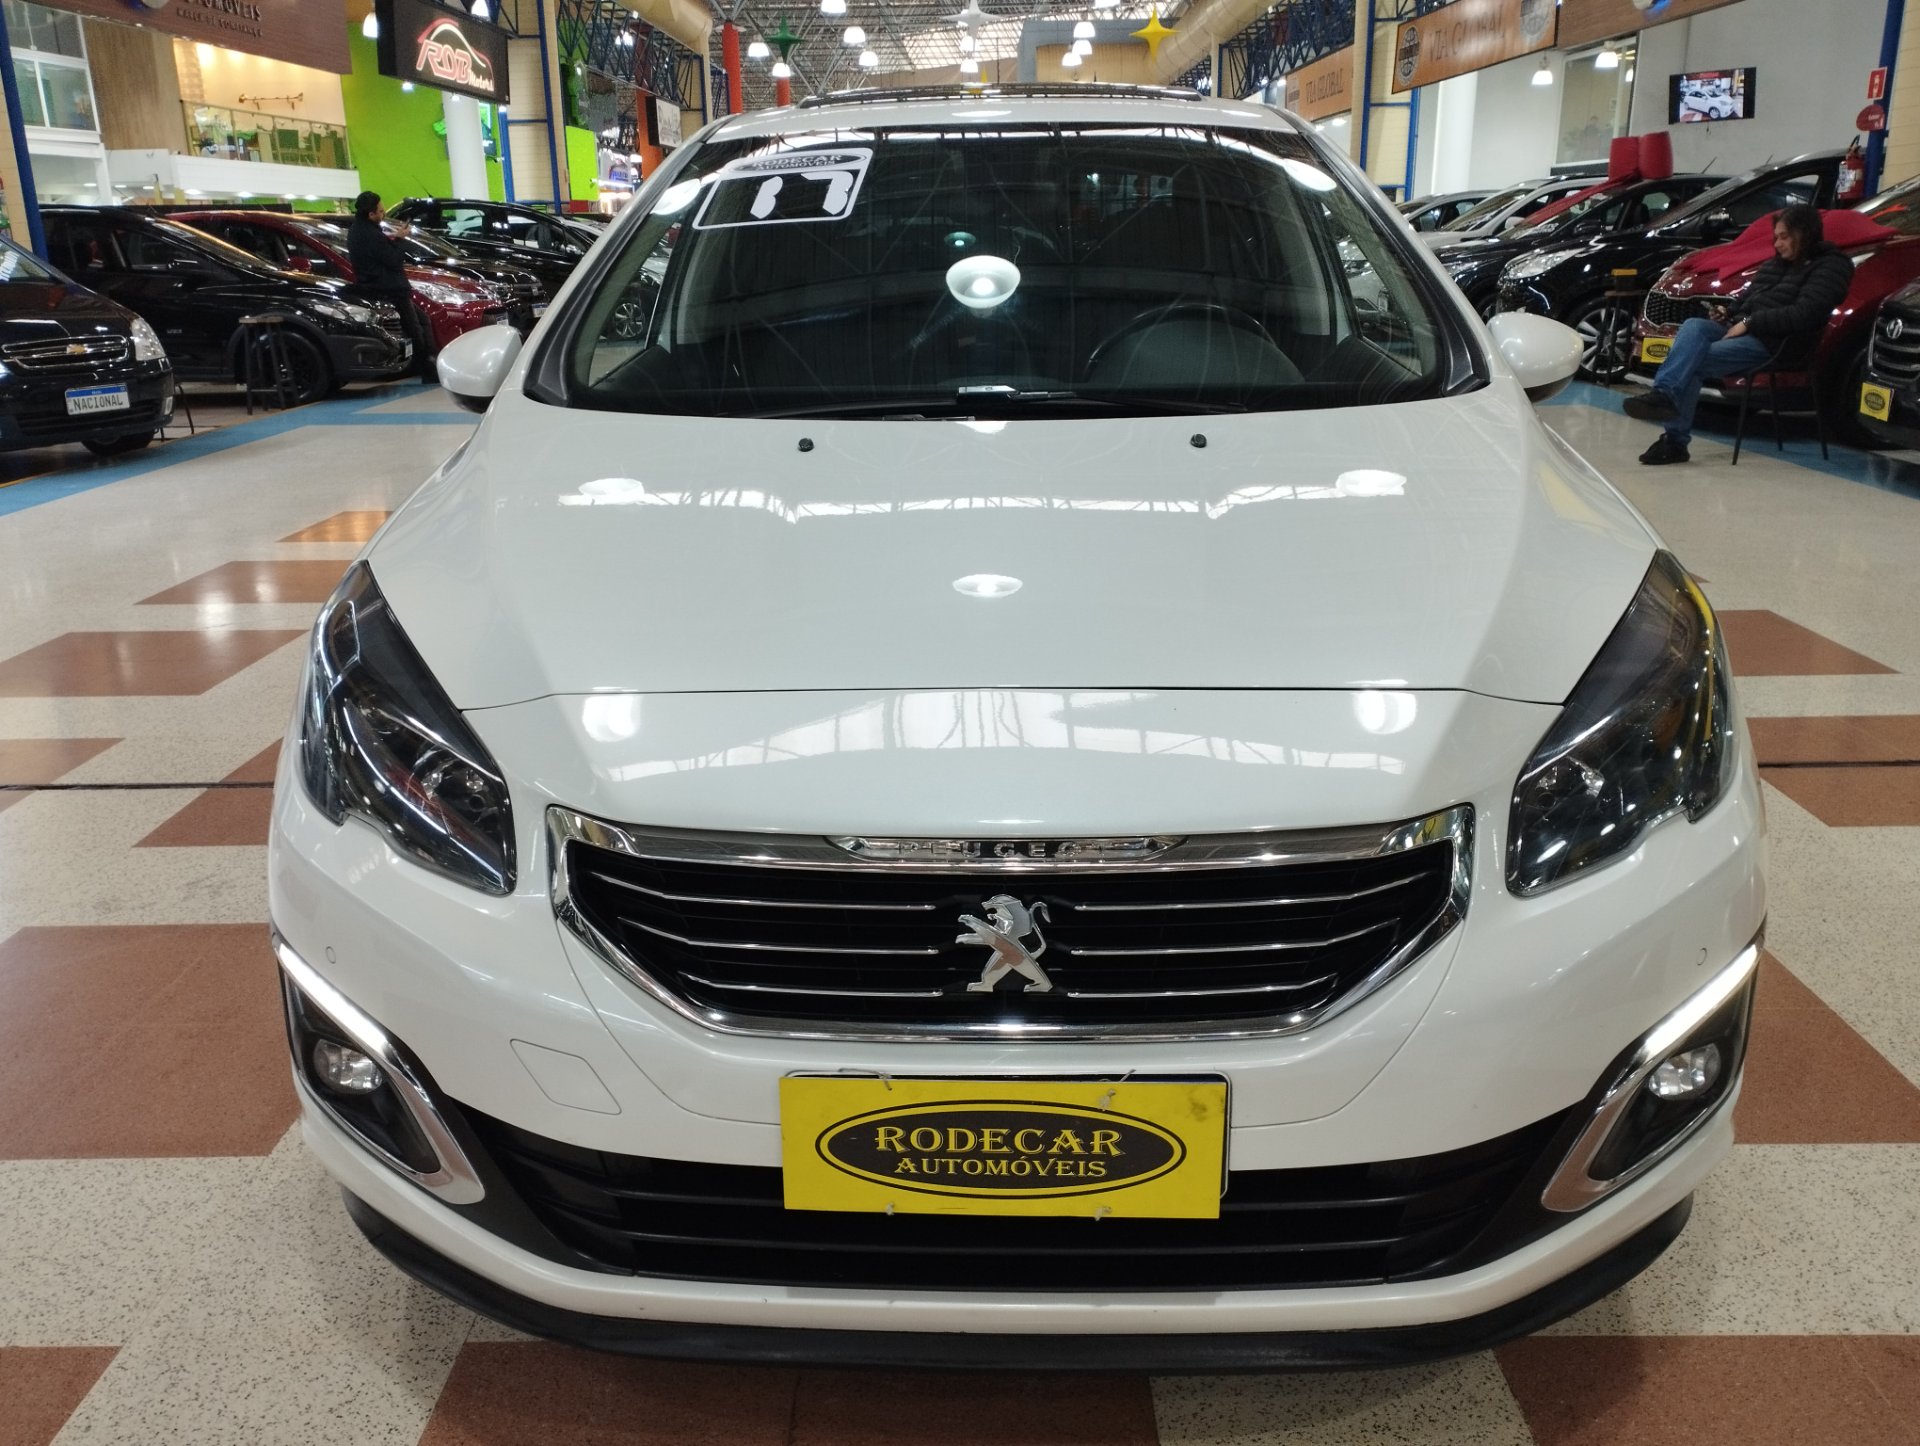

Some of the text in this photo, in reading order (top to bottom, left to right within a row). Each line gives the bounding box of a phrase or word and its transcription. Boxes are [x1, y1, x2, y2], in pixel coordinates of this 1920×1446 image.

[751, 154, 842, 168] RODECAR
[750, 170, 854, 220] 17
[72, 394, 124, 412] NACIONAL
[873, 1126, 1127, 1157] RODECAR
[893, 1154, 1108, 1178] AUTOMÓVEIS
